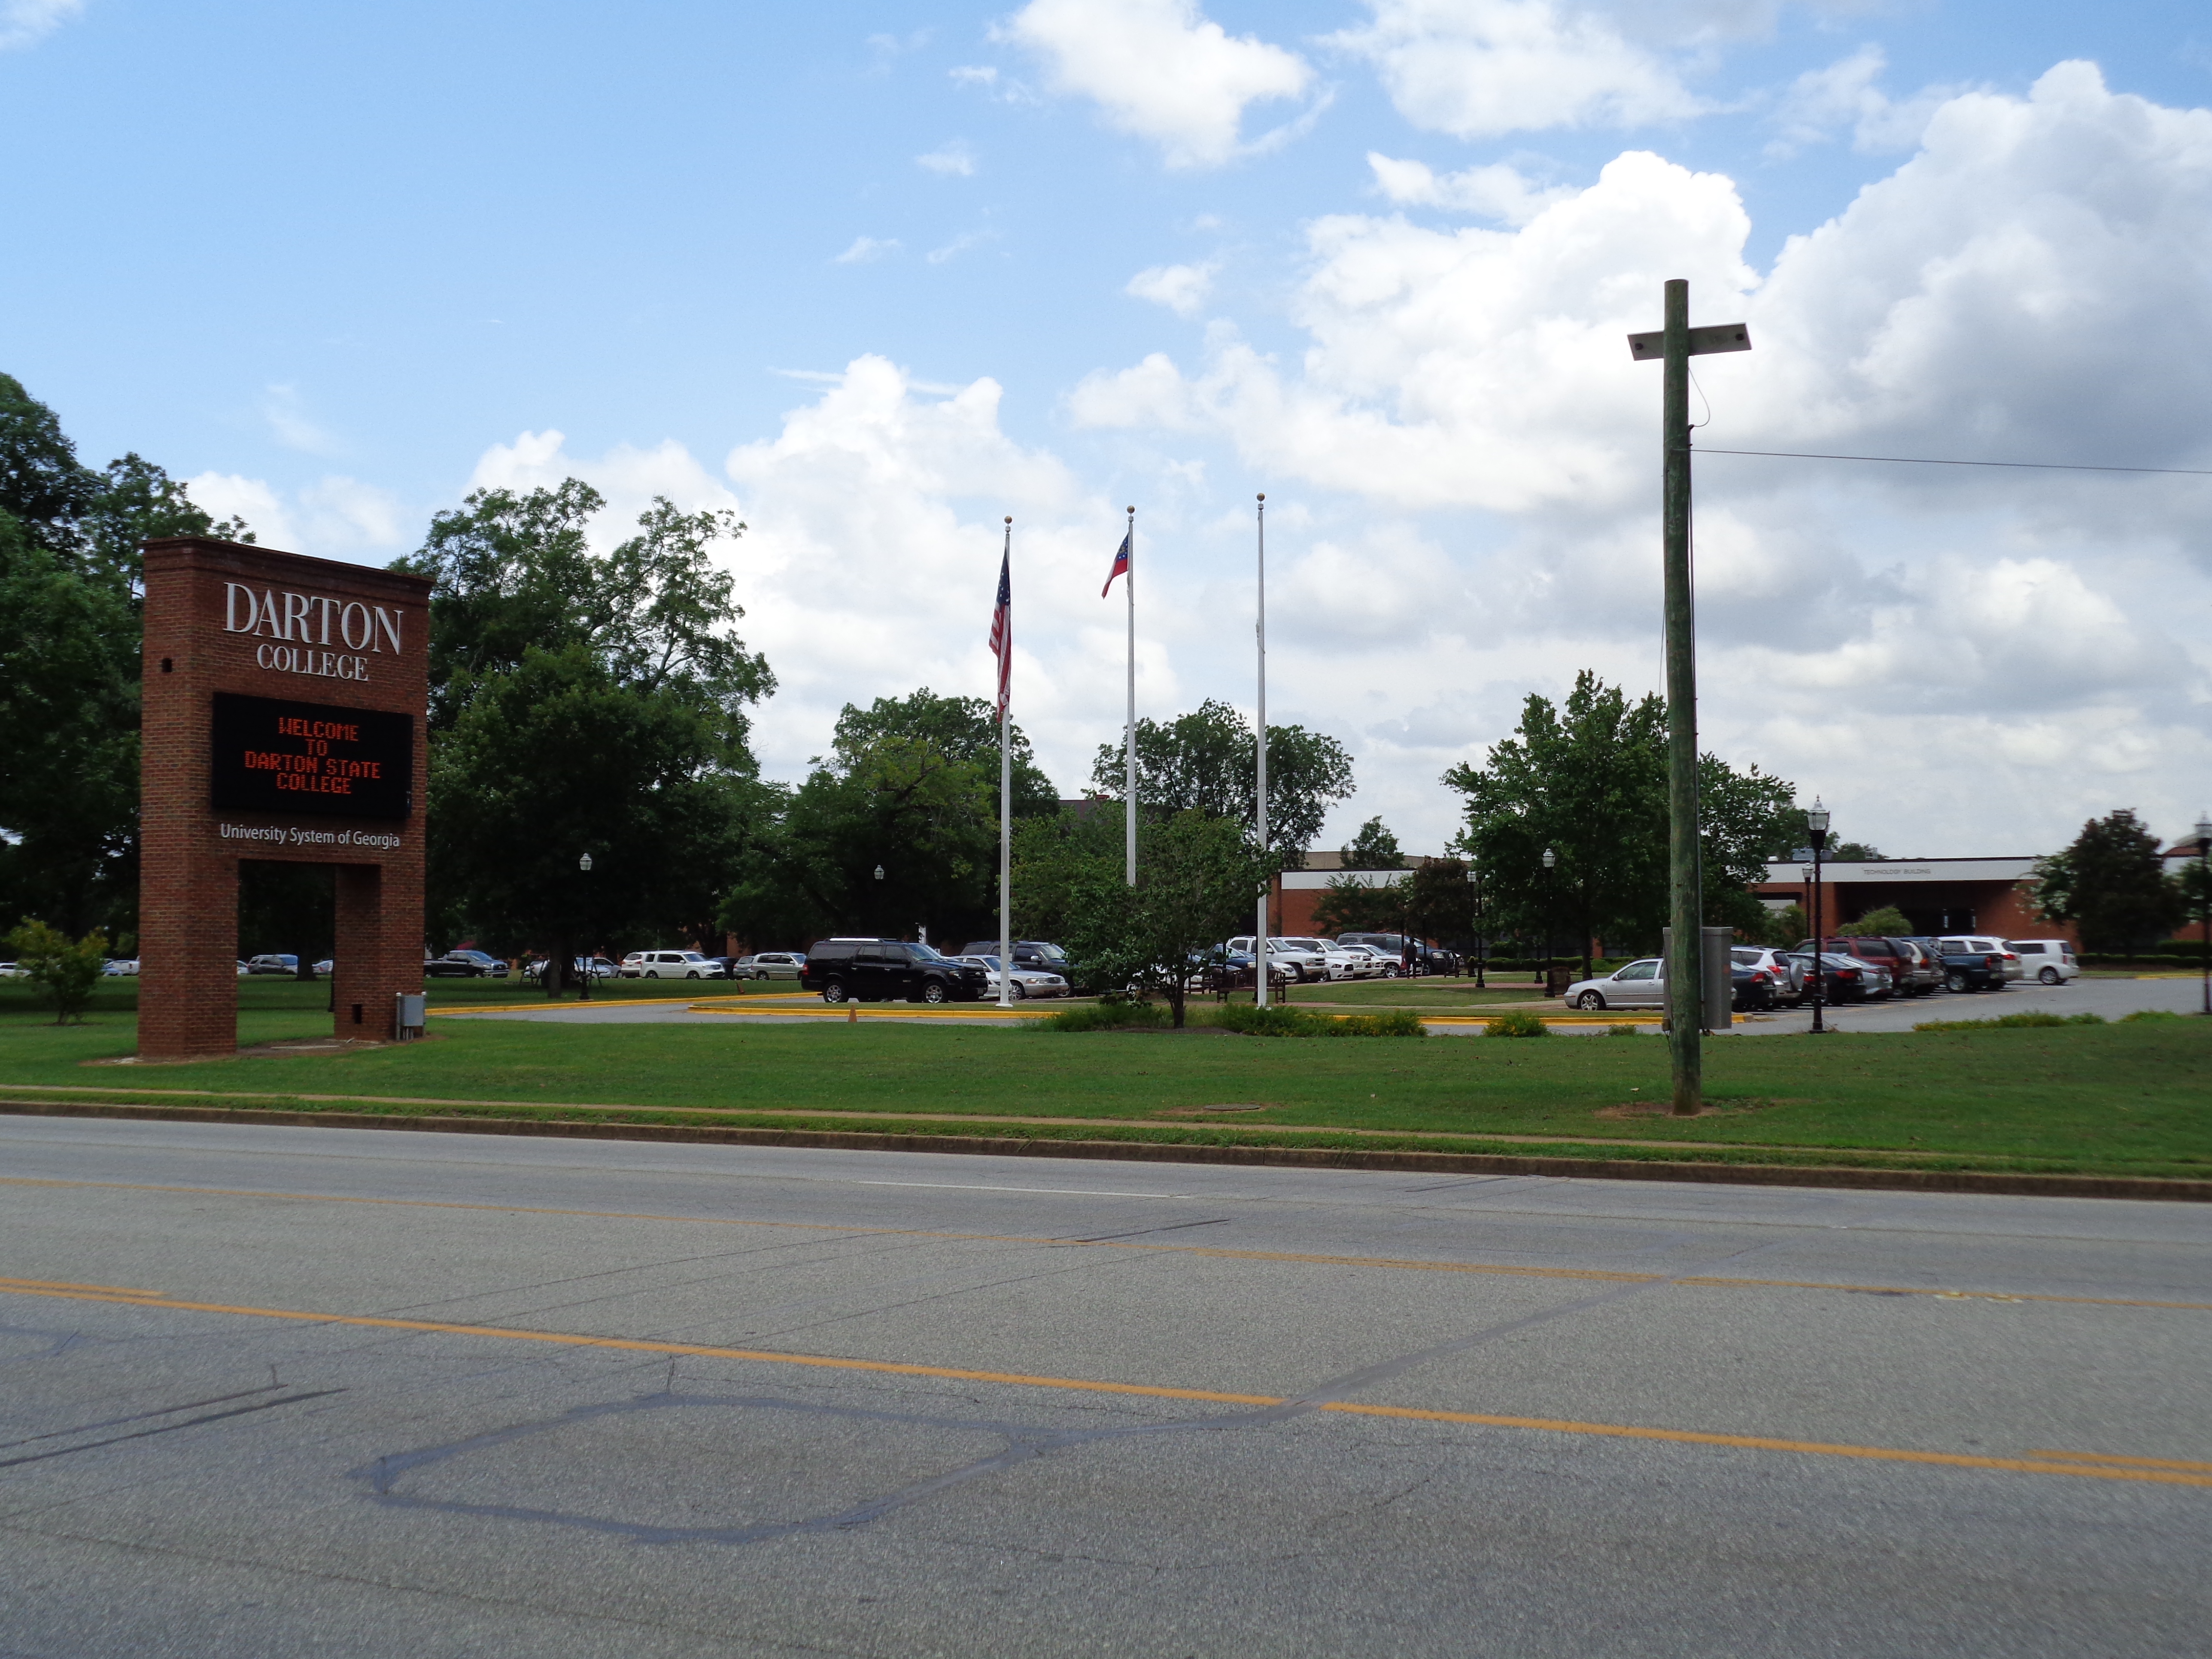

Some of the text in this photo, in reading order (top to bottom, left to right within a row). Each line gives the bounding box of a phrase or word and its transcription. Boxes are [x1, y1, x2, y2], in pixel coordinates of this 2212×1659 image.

[223, 582, 403, 655] DARTON
[257, 644, 368, 681] COLLEGE
[278, 717, 359, 741] WELCOME
[305, 738, 328, 756] TO
[244, 751, 380, 778] DARTON STATE
[276, 773, 351, 794] COLLEGE
[220, 823, 400, 850] University System of Georgia
